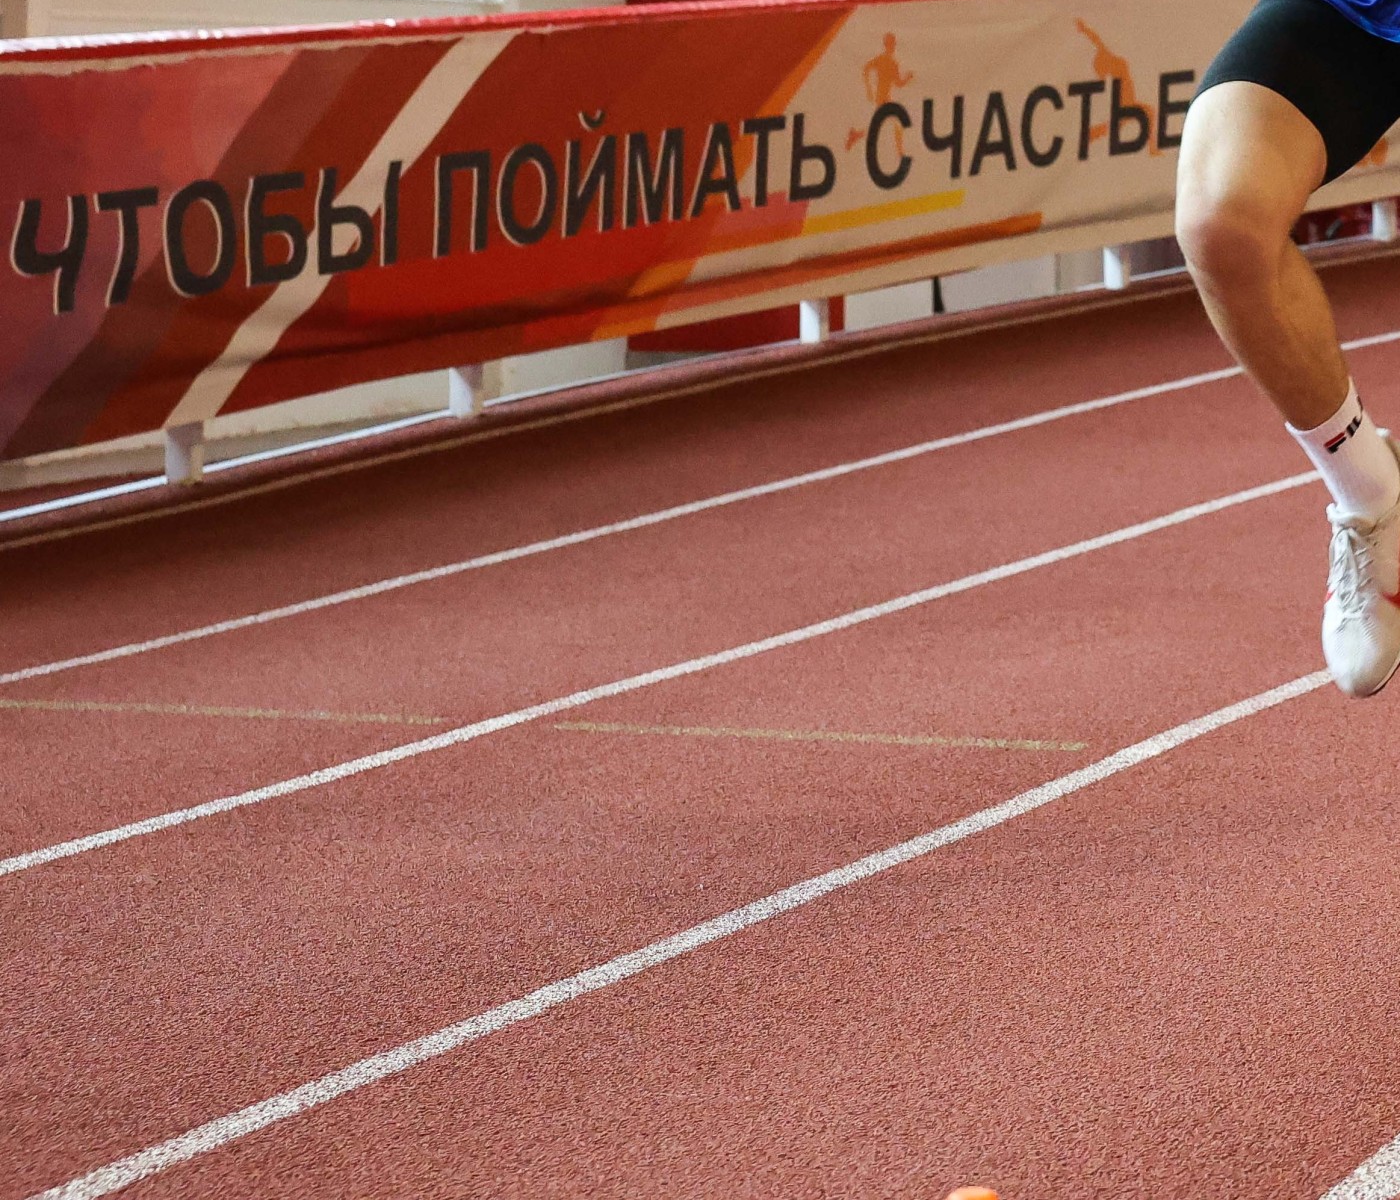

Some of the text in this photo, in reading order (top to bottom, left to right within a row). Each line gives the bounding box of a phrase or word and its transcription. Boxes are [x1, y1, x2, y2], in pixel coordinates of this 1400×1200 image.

[10, 160, 403, 316] ЧТОБЫ
[432, 109, 837, 260] ПОЙМАТЬ
[864, 69, 1195, 190] СЧАСТЬЕ
